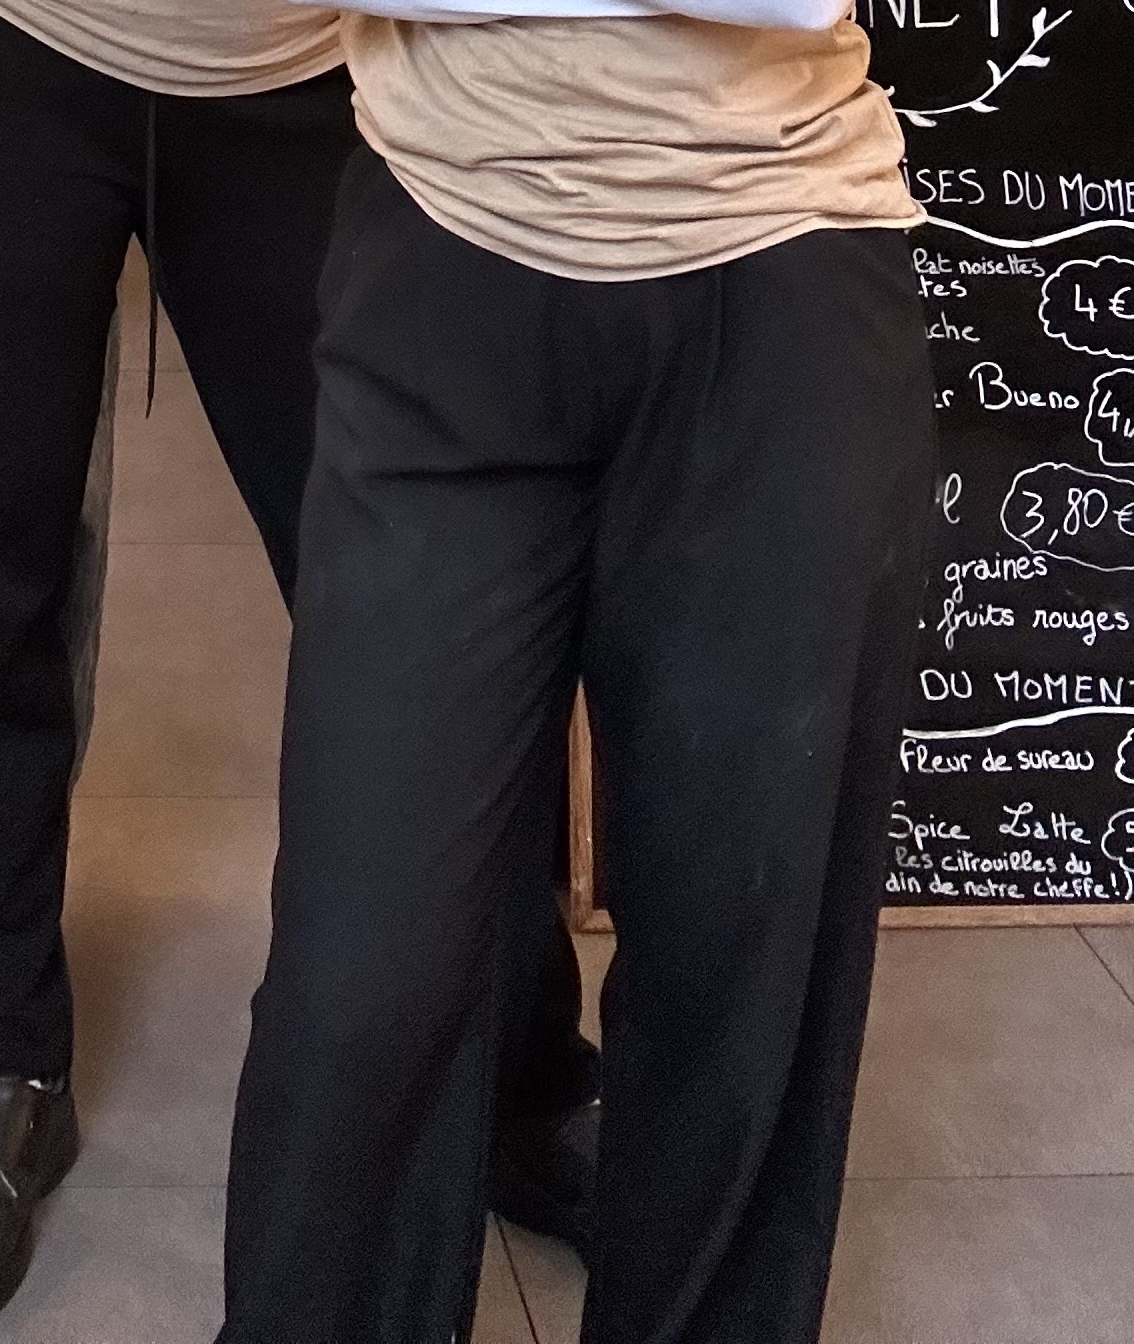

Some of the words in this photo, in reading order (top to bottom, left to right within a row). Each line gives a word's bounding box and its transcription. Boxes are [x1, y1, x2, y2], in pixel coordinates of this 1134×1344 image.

[1002, 169, 1046, 211] DU
[959, 254, 1046, 278] noisettes
[918, 275, 967, 298] tes
[925, 312, 981, 342] che
[969, 362, 1080, 410] Bueno
[944, 552, 1048, 603] graines
[936, 598, 1015, 651] fruits
[1032, 610, 1130, 647] rouges
[920, 669, 972, 701] DU
[900, 738, 972, 773] Fleur
[982, 748, 1013, 772] de
[1017, 749, 1095, 771] sureau
[888, 800, 970, 851] Spice
[999, 802, 1092, 845] Latte
[941, 849, 1057, 874] citrouilles
[1065, 852, 1092, 876] du
[929, 872, 959, 897] de
[964, 878, 1025, 899] notre
